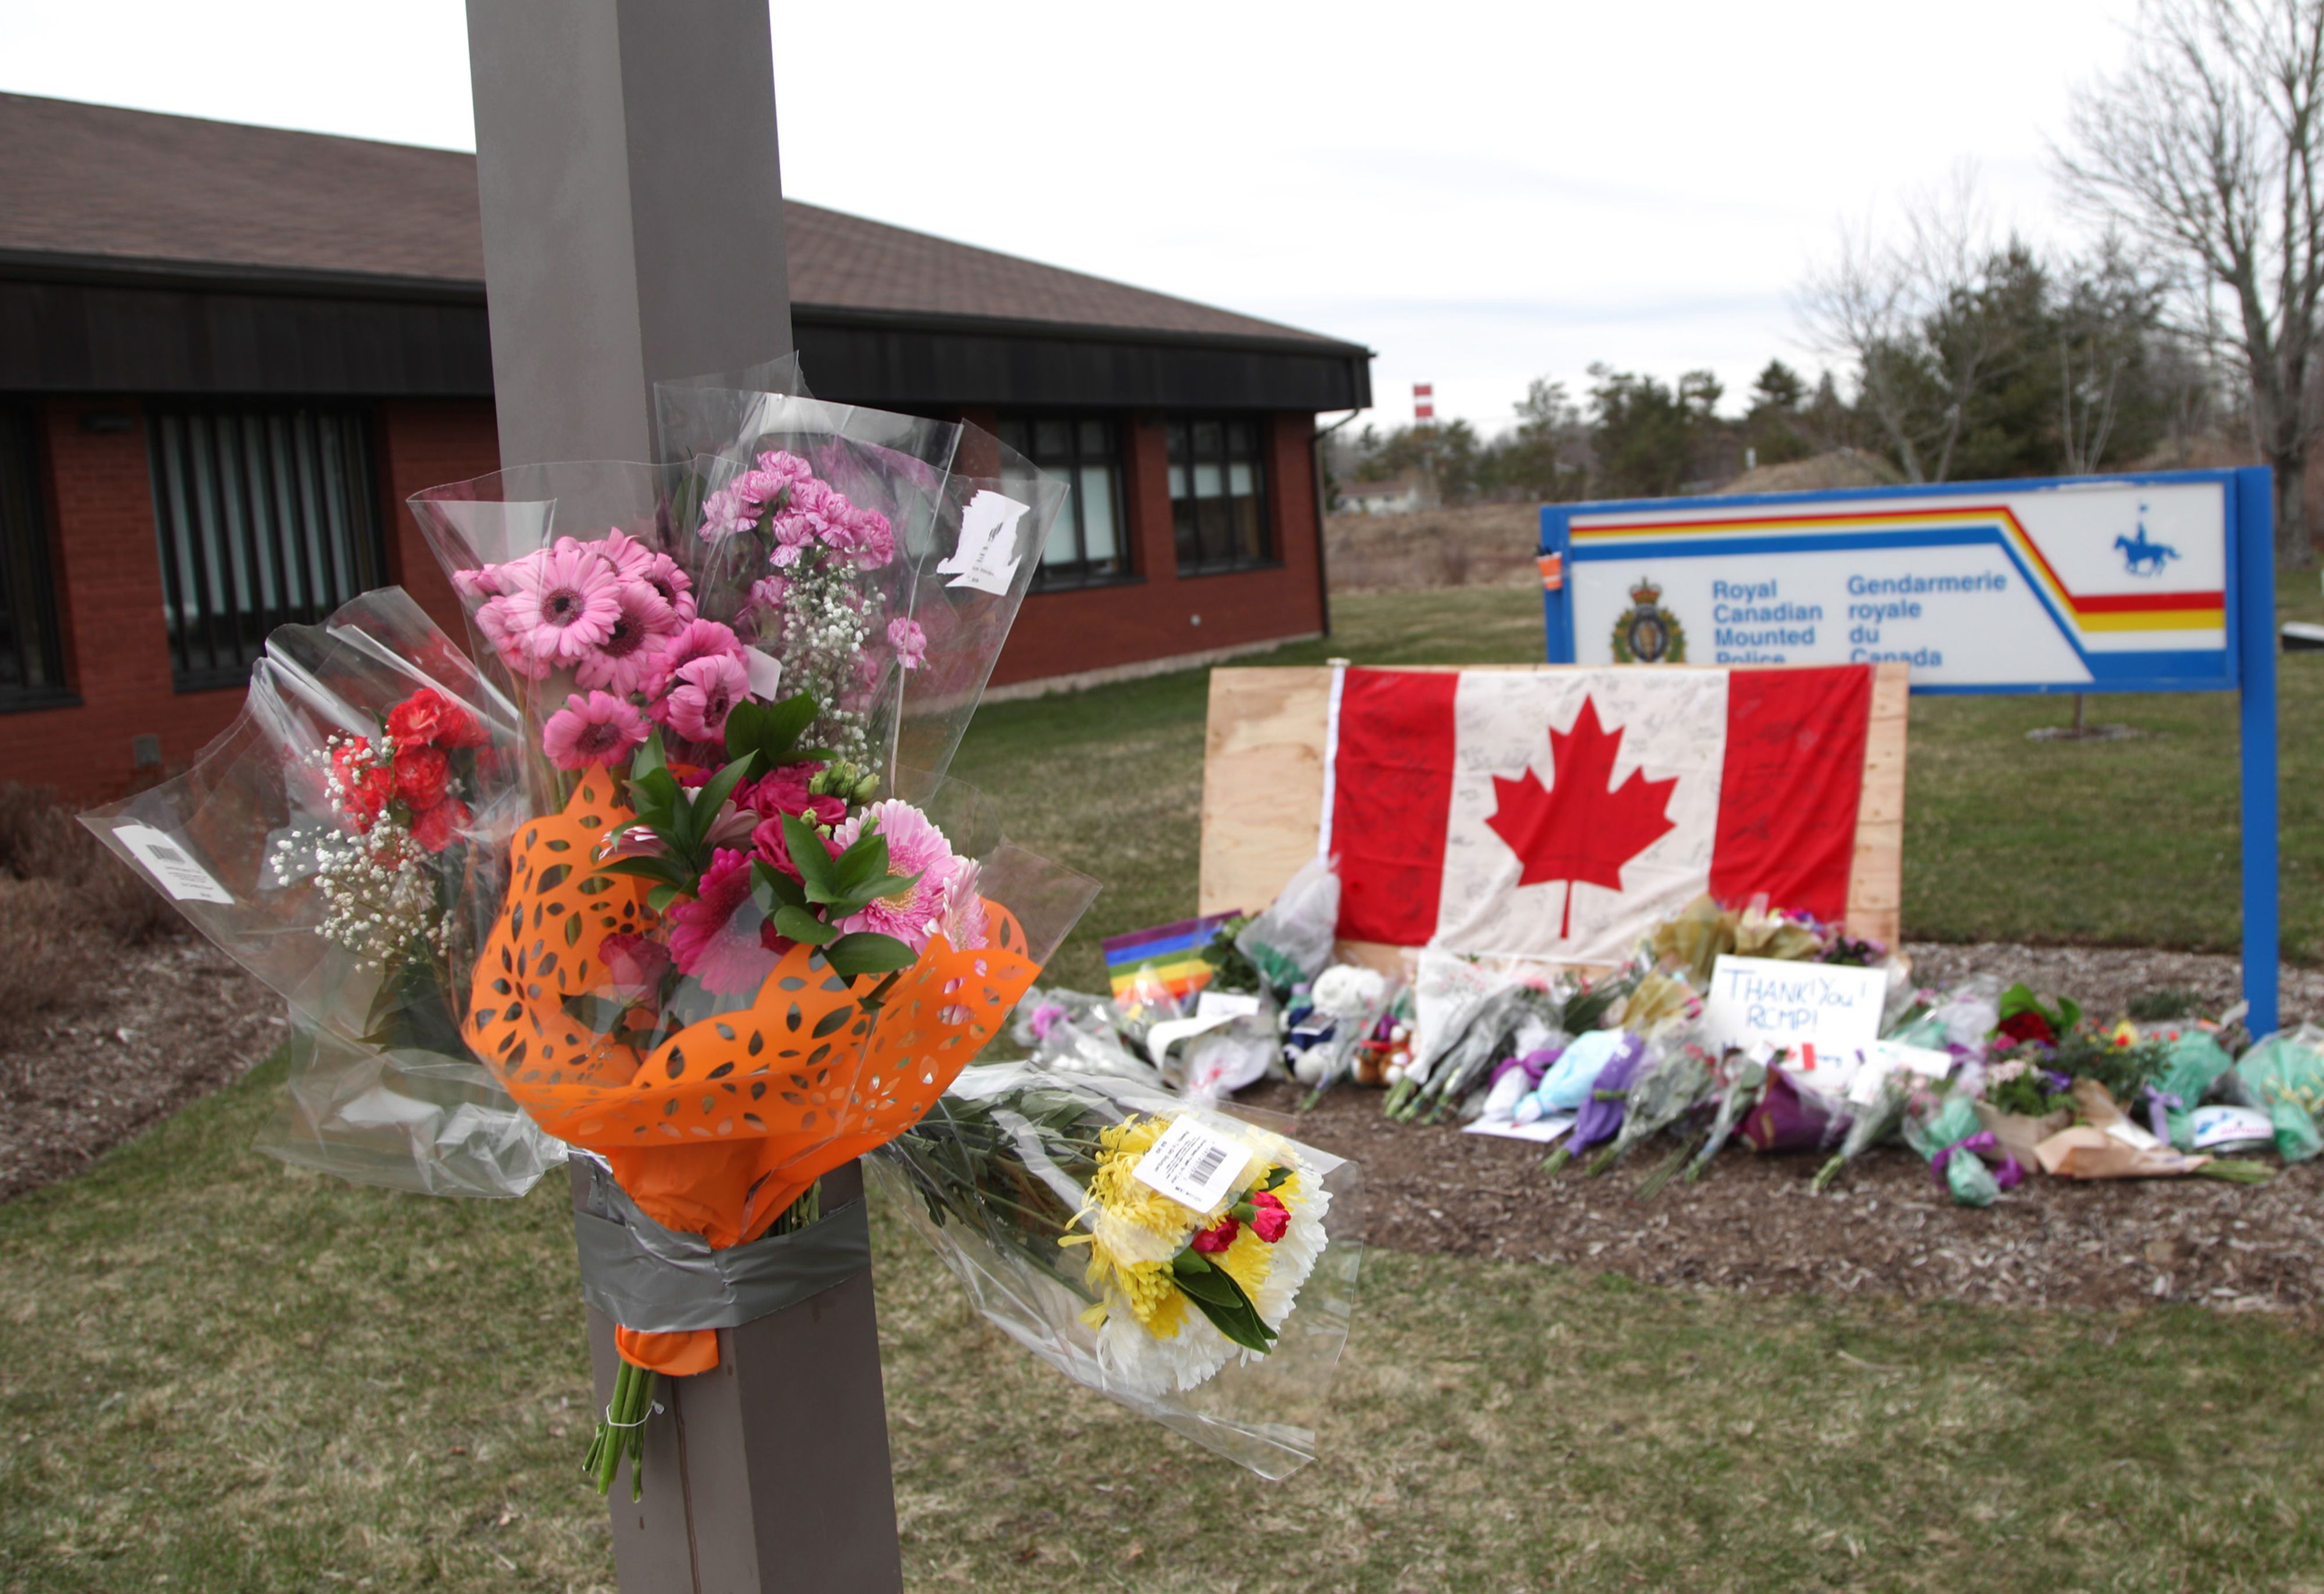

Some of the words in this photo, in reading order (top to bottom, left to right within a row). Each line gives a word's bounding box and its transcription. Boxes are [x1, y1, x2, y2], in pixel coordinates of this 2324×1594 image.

[1713, 580, 1777, 603] Royal
[1848, 571, 2007, 596] Gendarmerie
[1713, 602, 1823, 624] Canadian
[1849, 599, 1922, 624] royale
[1715, 626, 1815, 647] Mounted
[1849, 625, 1880, 644] du
[1850, 646, 1943, 667] Canada
